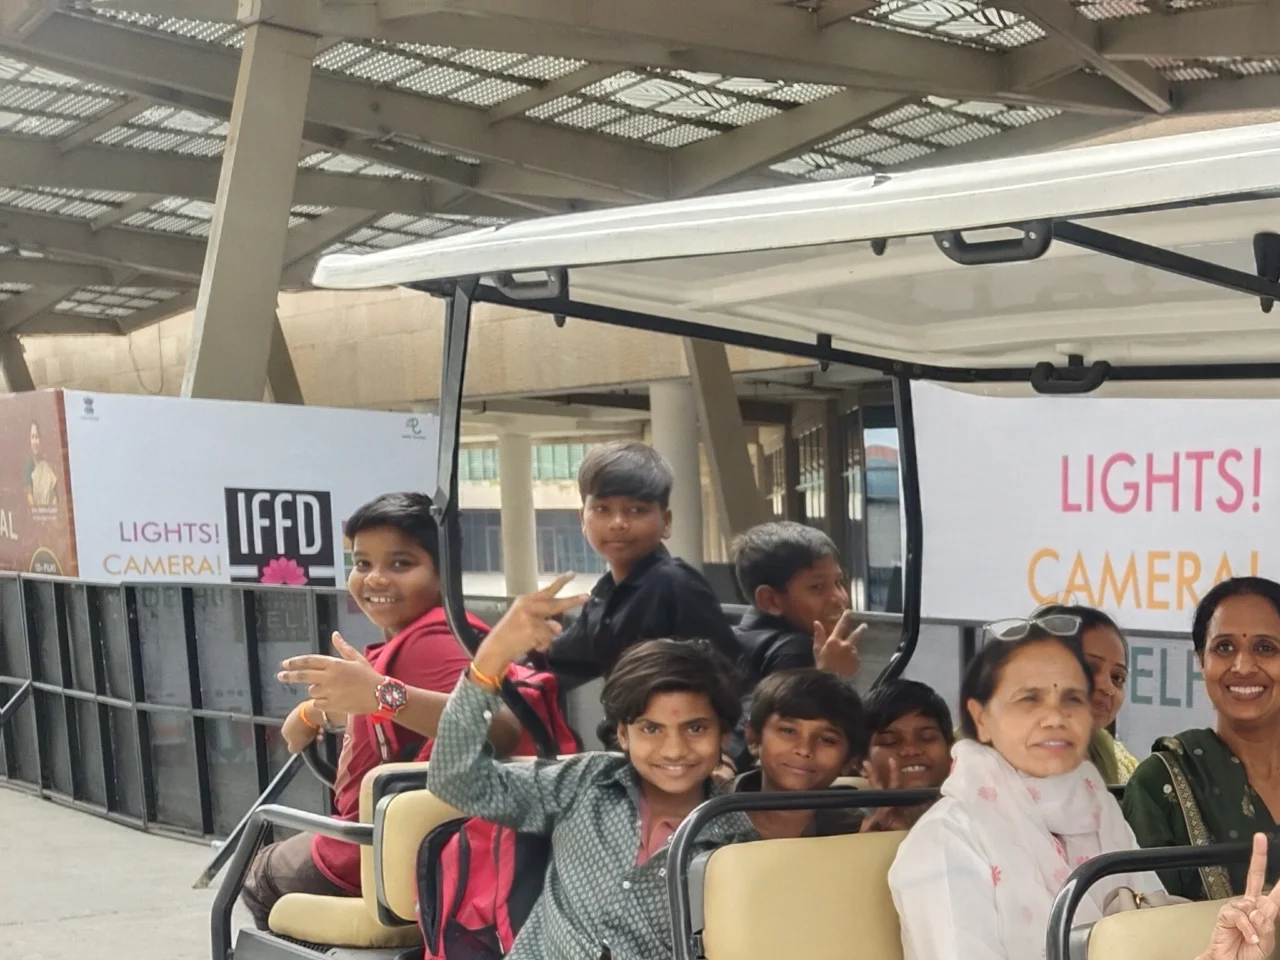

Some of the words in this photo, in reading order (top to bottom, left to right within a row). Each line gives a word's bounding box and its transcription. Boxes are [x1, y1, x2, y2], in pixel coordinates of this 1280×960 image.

[1059, 448, 1263, 515] LIGHTS!
[119, 521, 220, 544] LIGHTS!
[237, 490, 322, 555] IFFD
[102, 553, 222, 578] CAMERA!
